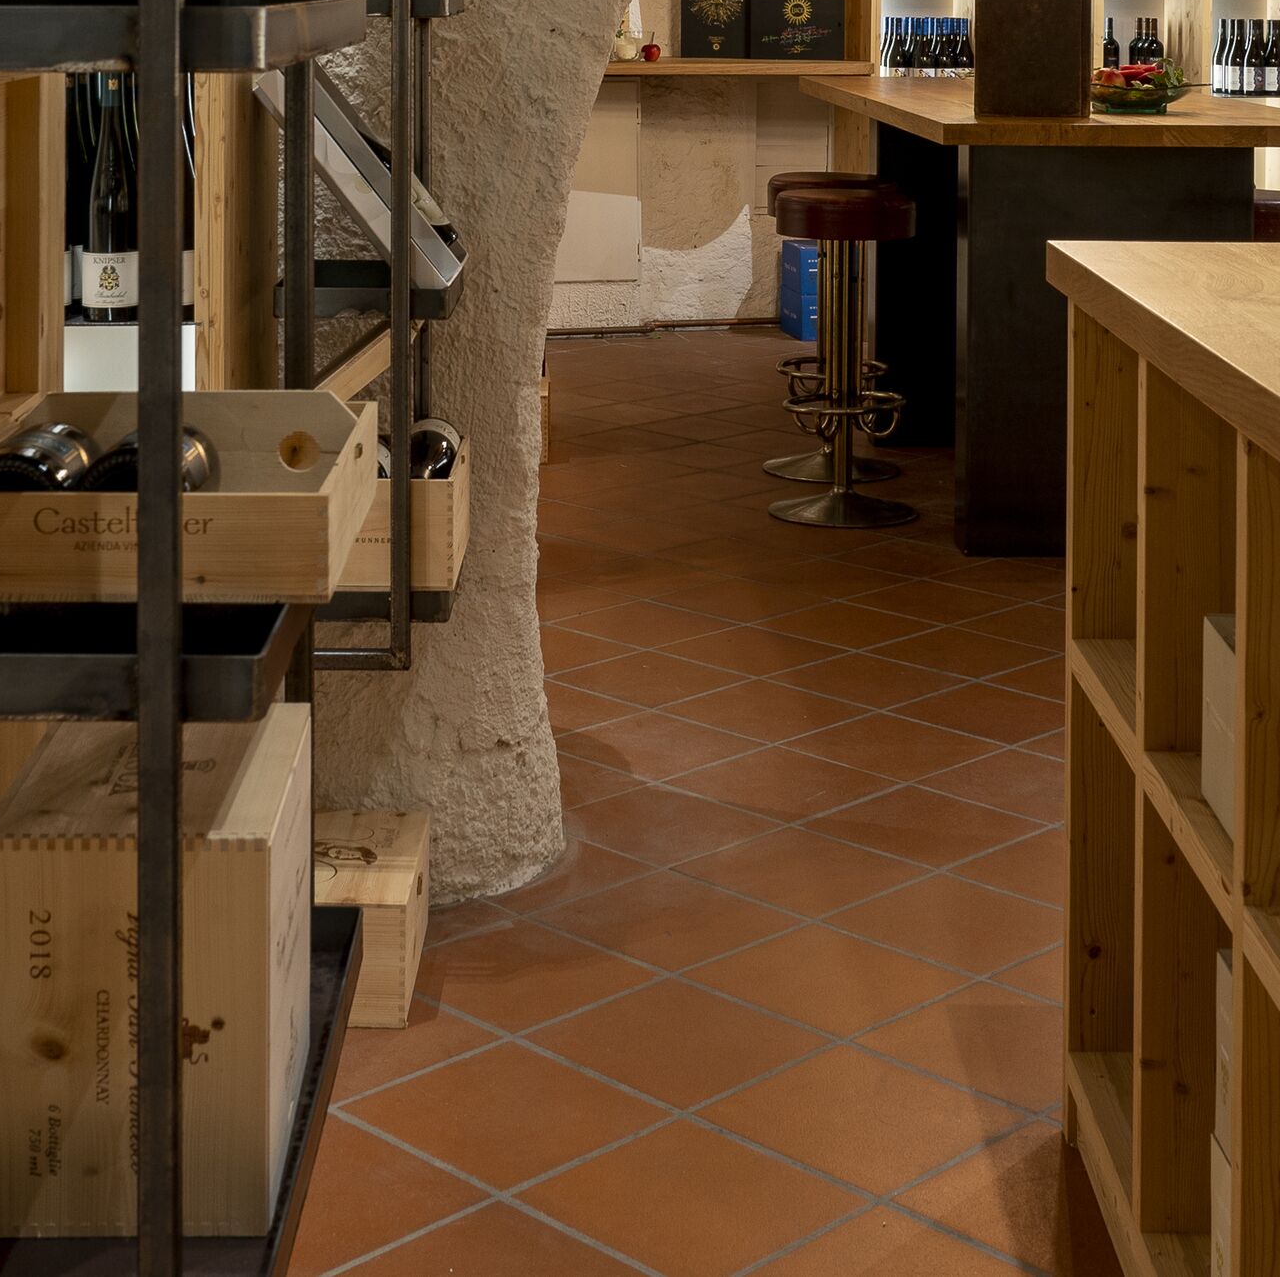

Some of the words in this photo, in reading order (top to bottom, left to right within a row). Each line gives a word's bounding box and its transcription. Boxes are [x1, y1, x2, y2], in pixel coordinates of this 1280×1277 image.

[93, 256, 126, 264] KNIPSER
[73, 540, 120, 552] AZIENDA
[29, 910, 53, 980] 2018
[95, 988, 111, 1106] CHARDONNAY
[44, 1115, 62, 1177] Bottiglie
